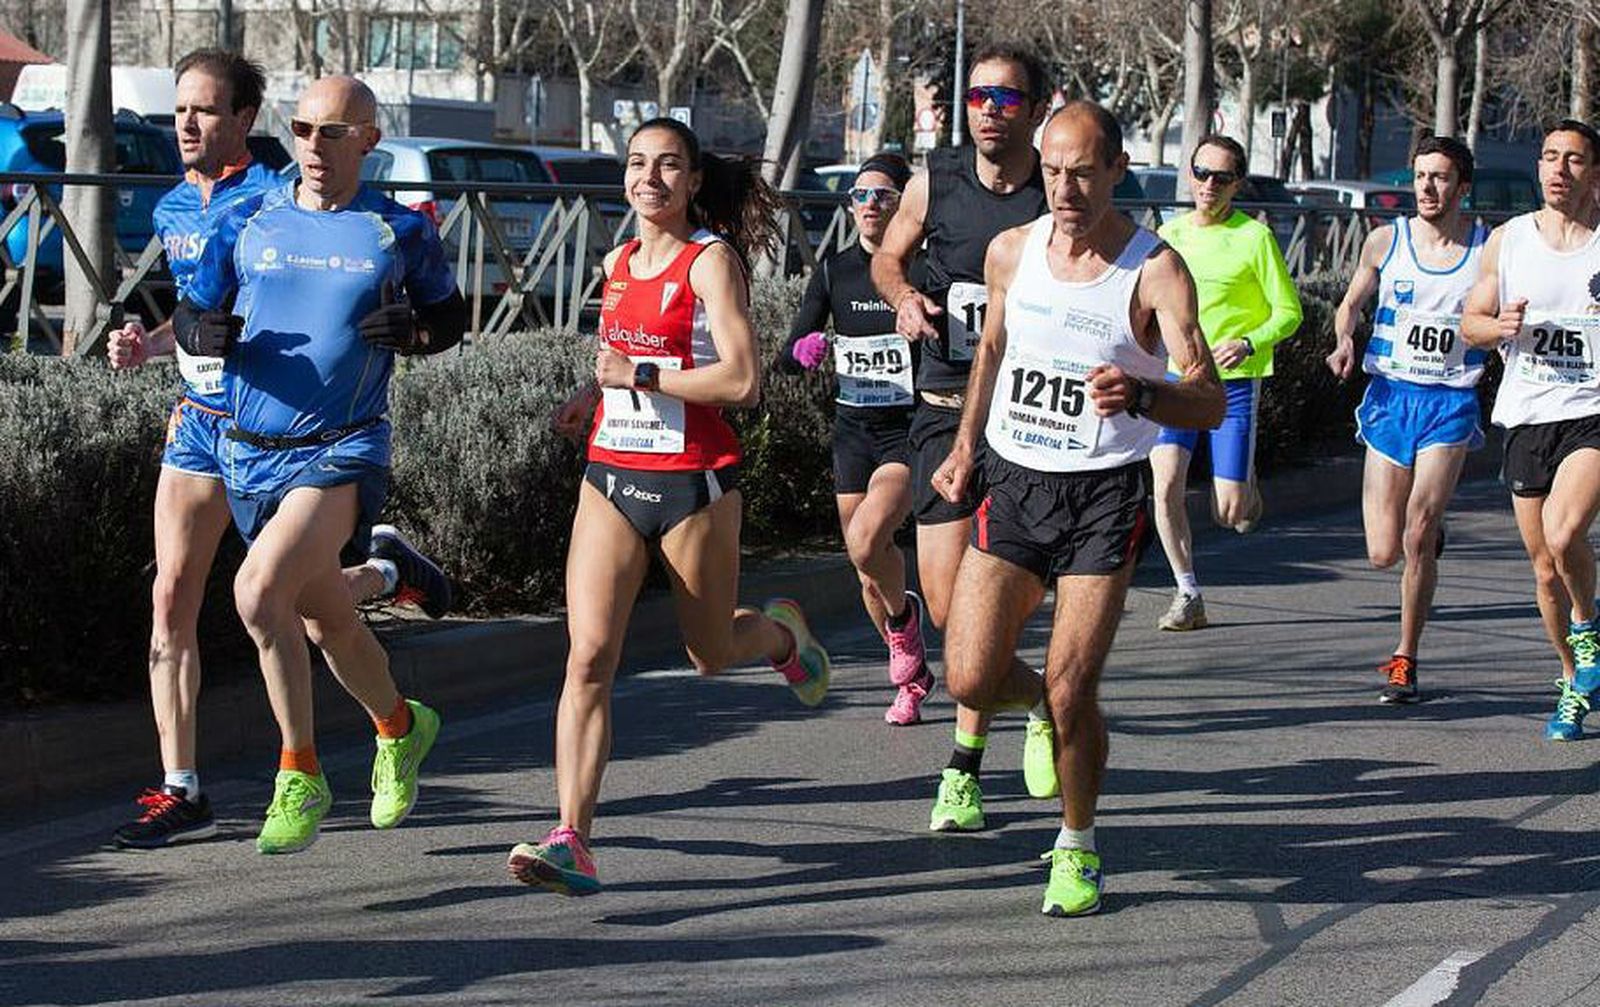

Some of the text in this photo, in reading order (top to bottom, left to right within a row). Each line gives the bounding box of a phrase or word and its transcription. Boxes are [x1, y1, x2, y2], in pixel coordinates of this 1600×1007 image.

[608, 320, 668, 348] alquiber
[1406, 324, 1456, 355] 460
[1532, 328, 1585, 357] 245
[844, 348, 903, 375] 1549
[1009, 366, 1087, 418] 1215
[1012, 429, 1063, 450] EL BERCIAL
[633, 489, 662, 503] asics
